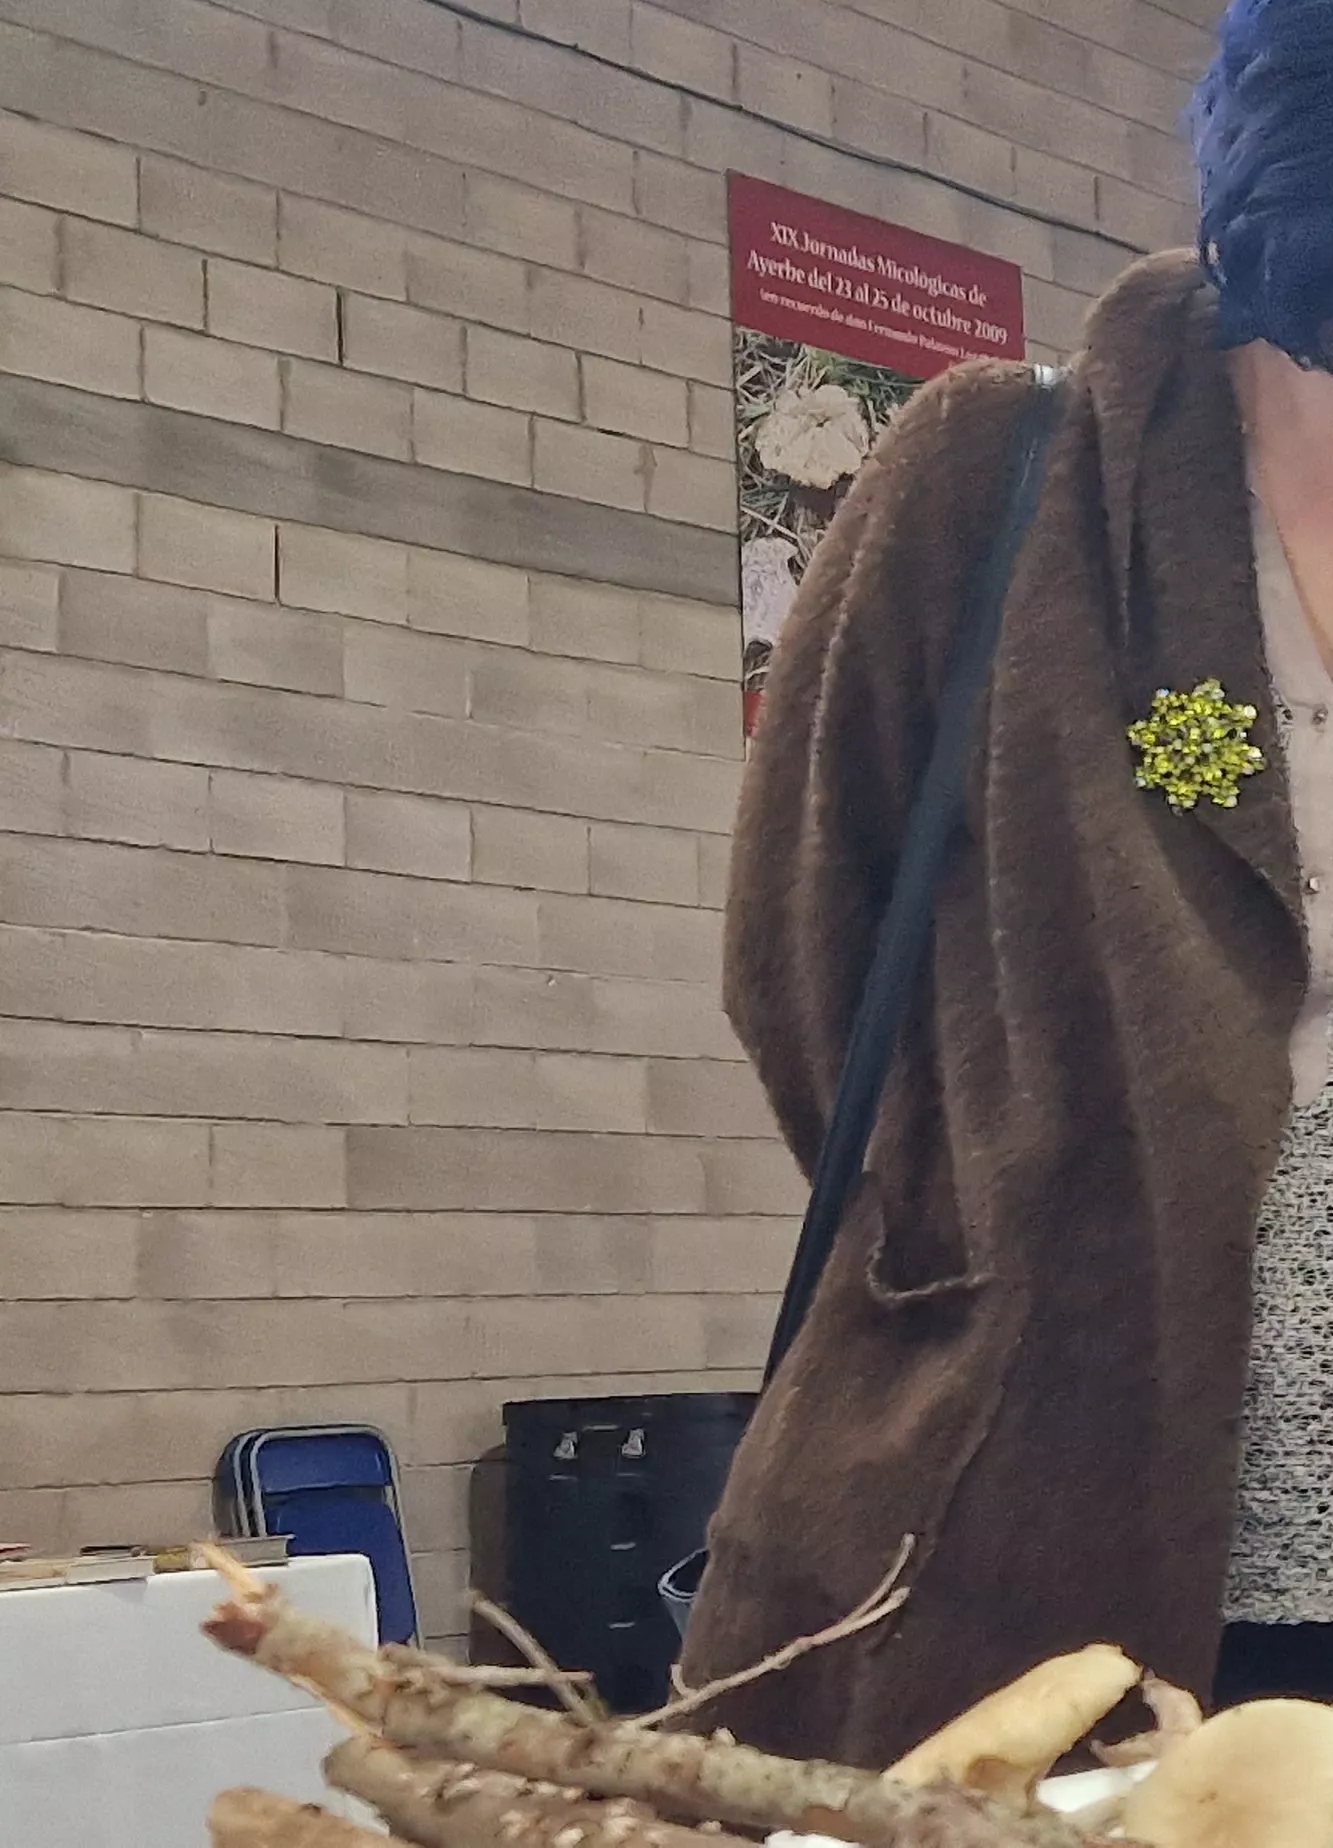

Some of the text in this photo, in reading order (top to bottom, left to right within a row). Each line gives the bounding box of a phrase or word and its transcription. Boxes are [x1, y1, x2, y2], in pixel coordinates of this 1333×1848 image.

[747, 249, 1008, 346] Ayerbe del 23 al 25 de octubre 2009
[770, 221, 799, 250] XIX
[800, 231, 876, 273] Jornadas
[968, 284, 988, 308] de
